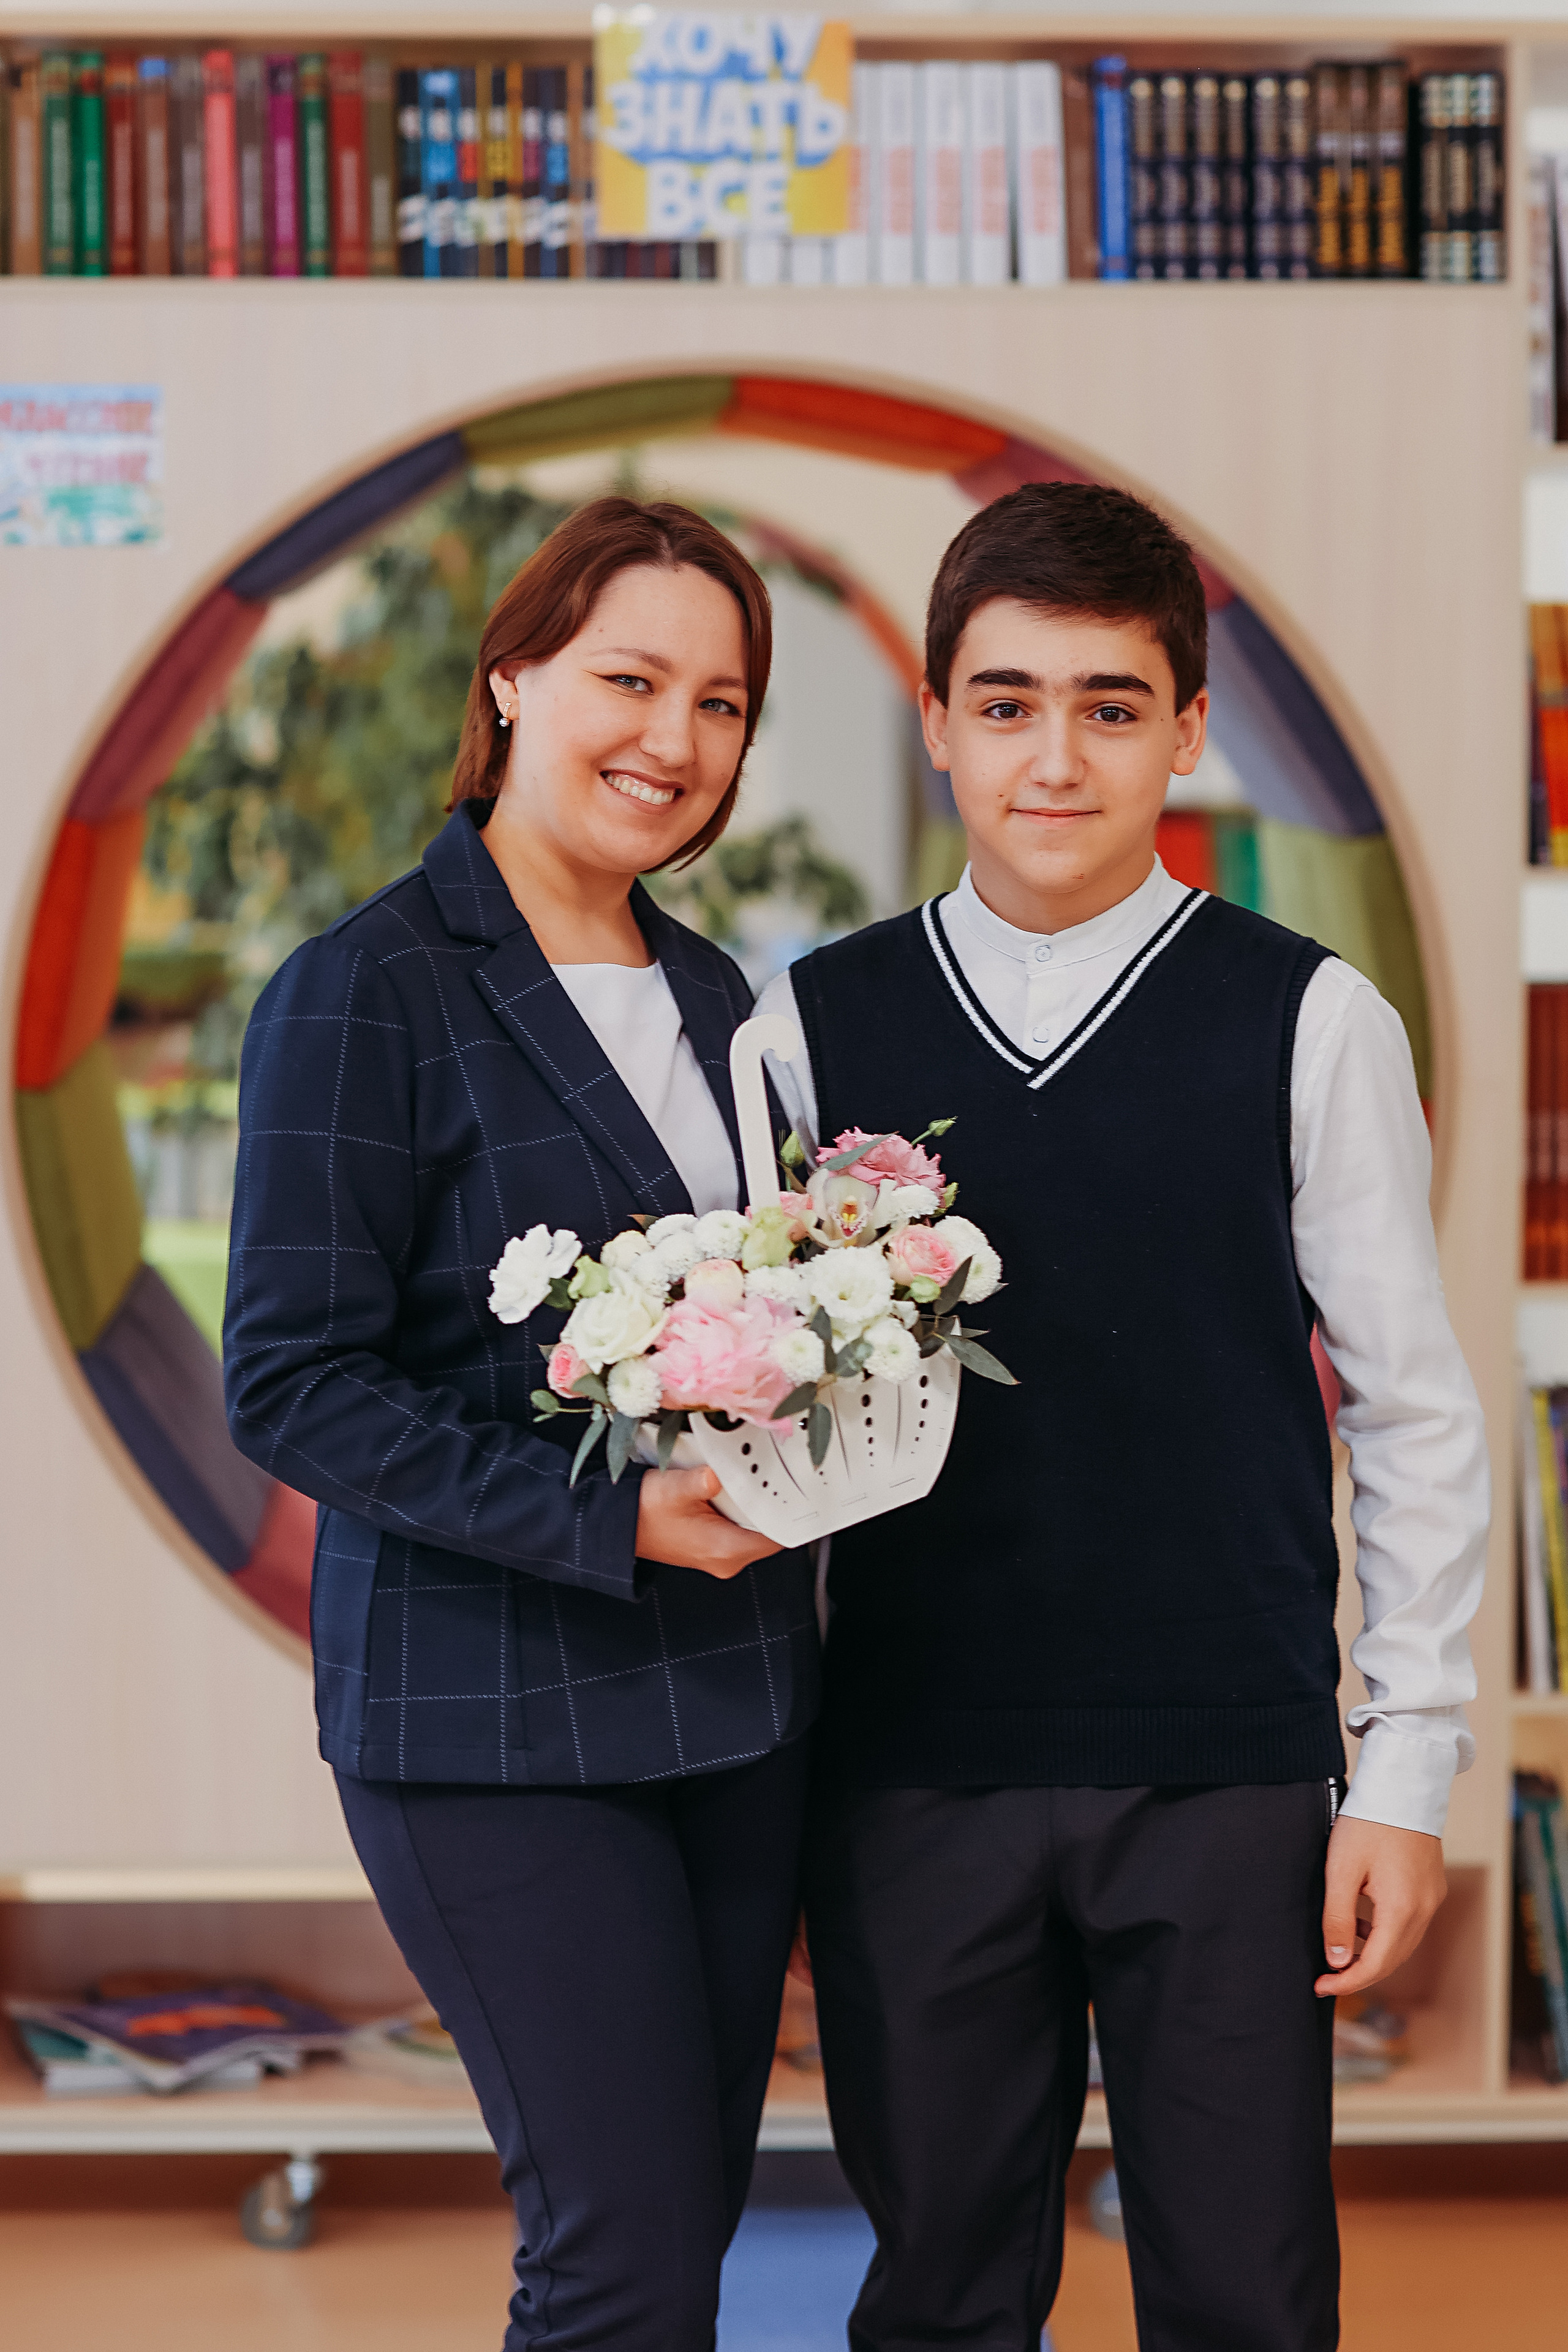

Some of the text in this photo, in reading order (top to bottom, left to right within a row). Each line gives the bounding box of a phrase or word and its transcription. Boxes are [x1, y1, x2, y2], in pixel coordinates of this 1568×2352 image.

[627, 13, 820, 75] ХОЧУ
[603, 80, 846, 153] ЗНАТЬ
[645, 160, 793, 236] ВСЕ
